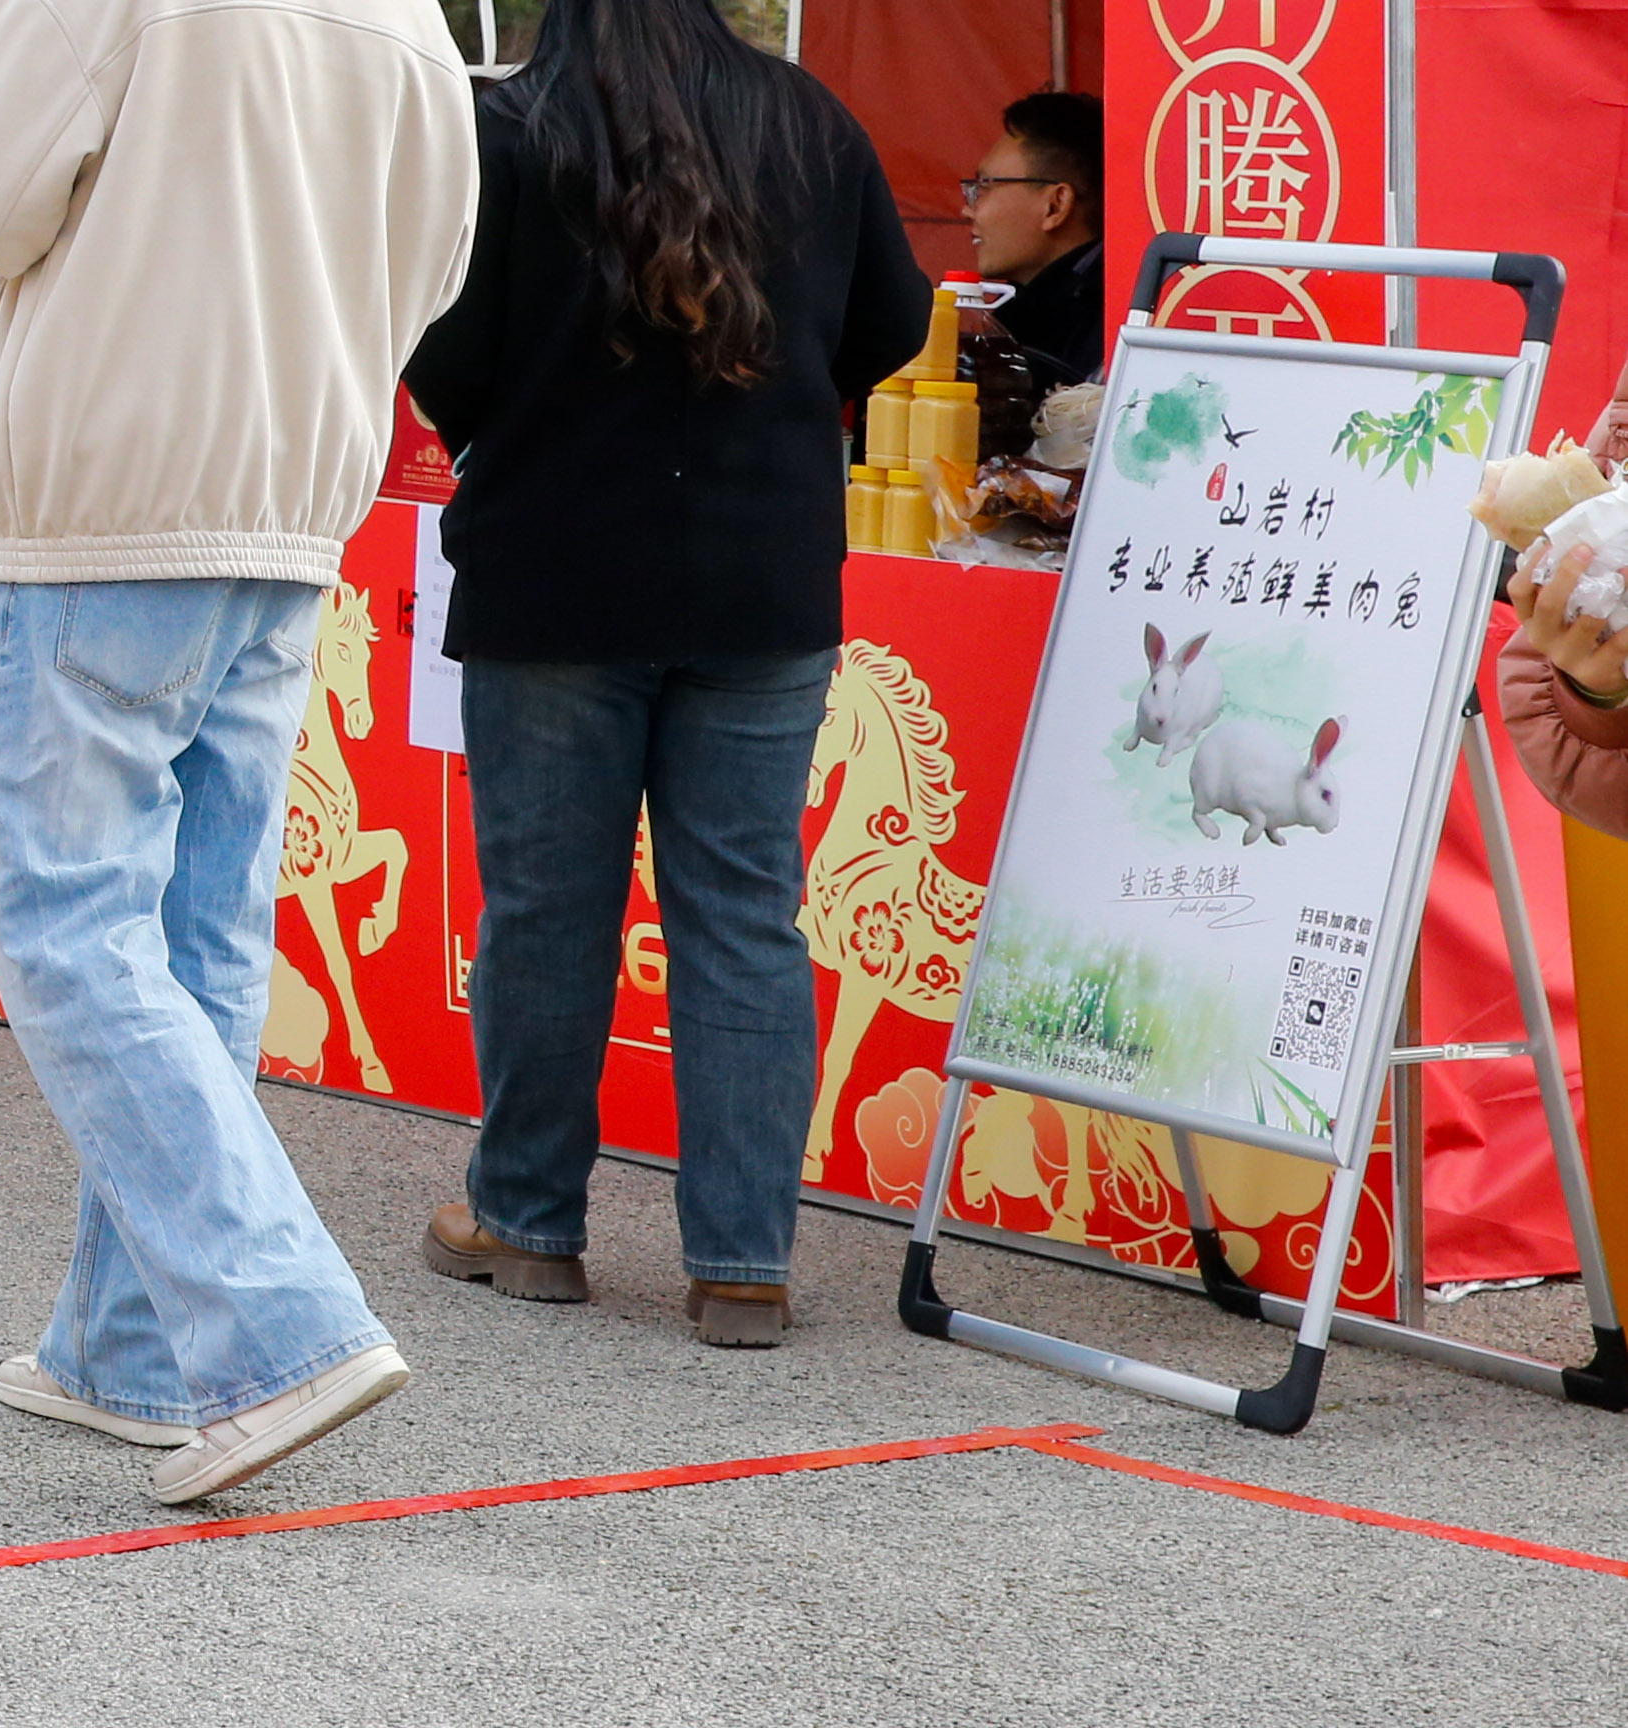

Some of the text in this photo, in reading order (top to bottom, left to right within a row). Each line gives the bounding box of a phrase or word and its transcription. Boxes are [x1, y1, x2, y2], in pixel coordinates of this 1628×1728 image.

[1218, 478, 1335, 541] 山岩村
[1108, 535, 1422, 630] 专业养殖鲜美肉兔
[1119, 863, 1241, 898] 生活要领鲜
[1299, 905, 1374, 936] 扫码加微信
[1295, 927, 1370, 958] 详情可咨询
